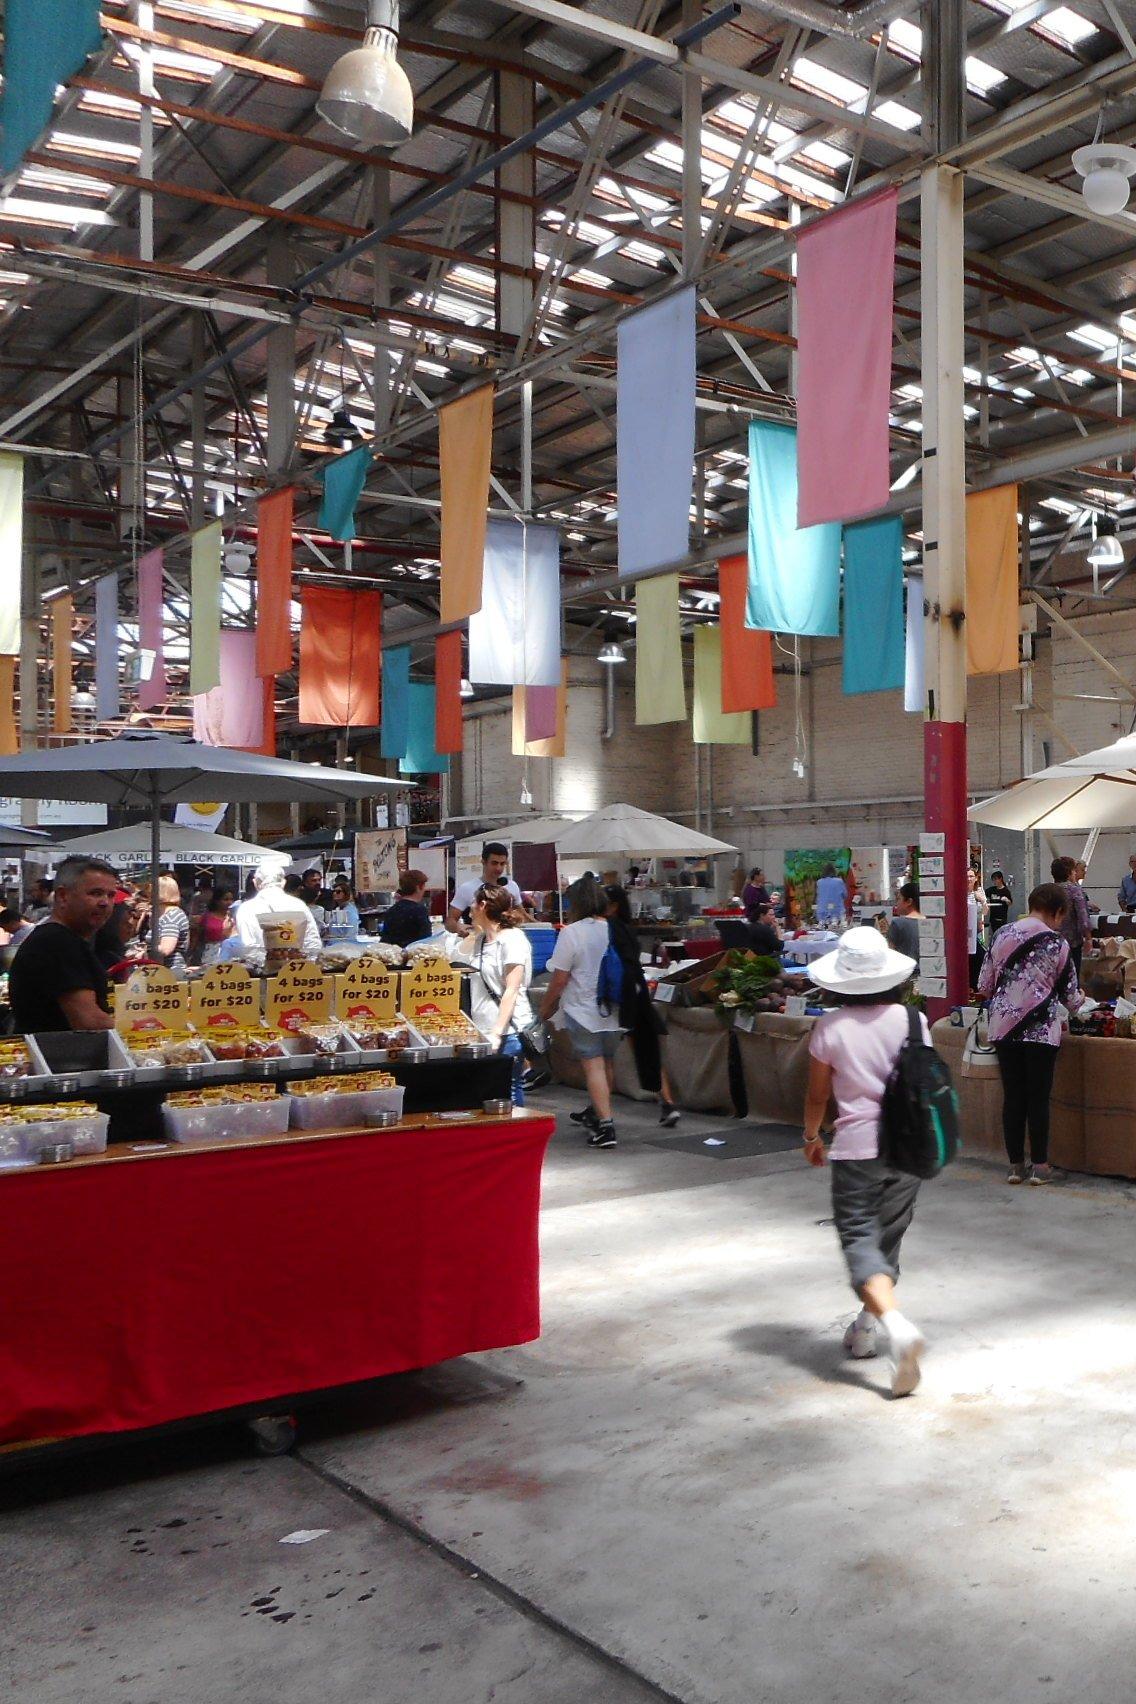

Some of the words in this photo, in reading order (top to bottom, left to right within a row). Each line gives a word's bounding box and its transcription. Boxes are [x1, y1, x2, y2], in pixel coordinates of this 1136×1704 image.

[176, 853, 214, 863] BLACK
[220, 854, 262, 864] GARLIC
[289, 962, 306, 972] $7
[358, 959, 374, 969] $7
[423, 958, 437, 968] $7
[141, 967, 159, 978] $7
[216, 964, 233, 975] $7
[279, 978, 288, 987] 4
[293, 977, 323, 988] bags
[348, 974, 357, 983] 4
[361, 974, 390, 984] bags
[414, 974, 422, 983] 4
[426, 973, 454, 983] bags
[130, 984, 140, 994] 4
[147, 983, 180, 995] bags
[205, 981, 216, 990] 4
[221, 981, 252, 992] bags
[273, 994, 293, 1003] for
[299, 991, 324, 1002] $20
[342, 989, 362, 999] for
[365, 989, 389, 999] $20
[409, 989, 428, 998] for
[432, 987, 455, 997] $20
[125, 1000, 147, 1011] for
[153, 999, 181, 1010] $20
[201, 997, 221, 1008] for
[226, 995, 253, 1006] $20
